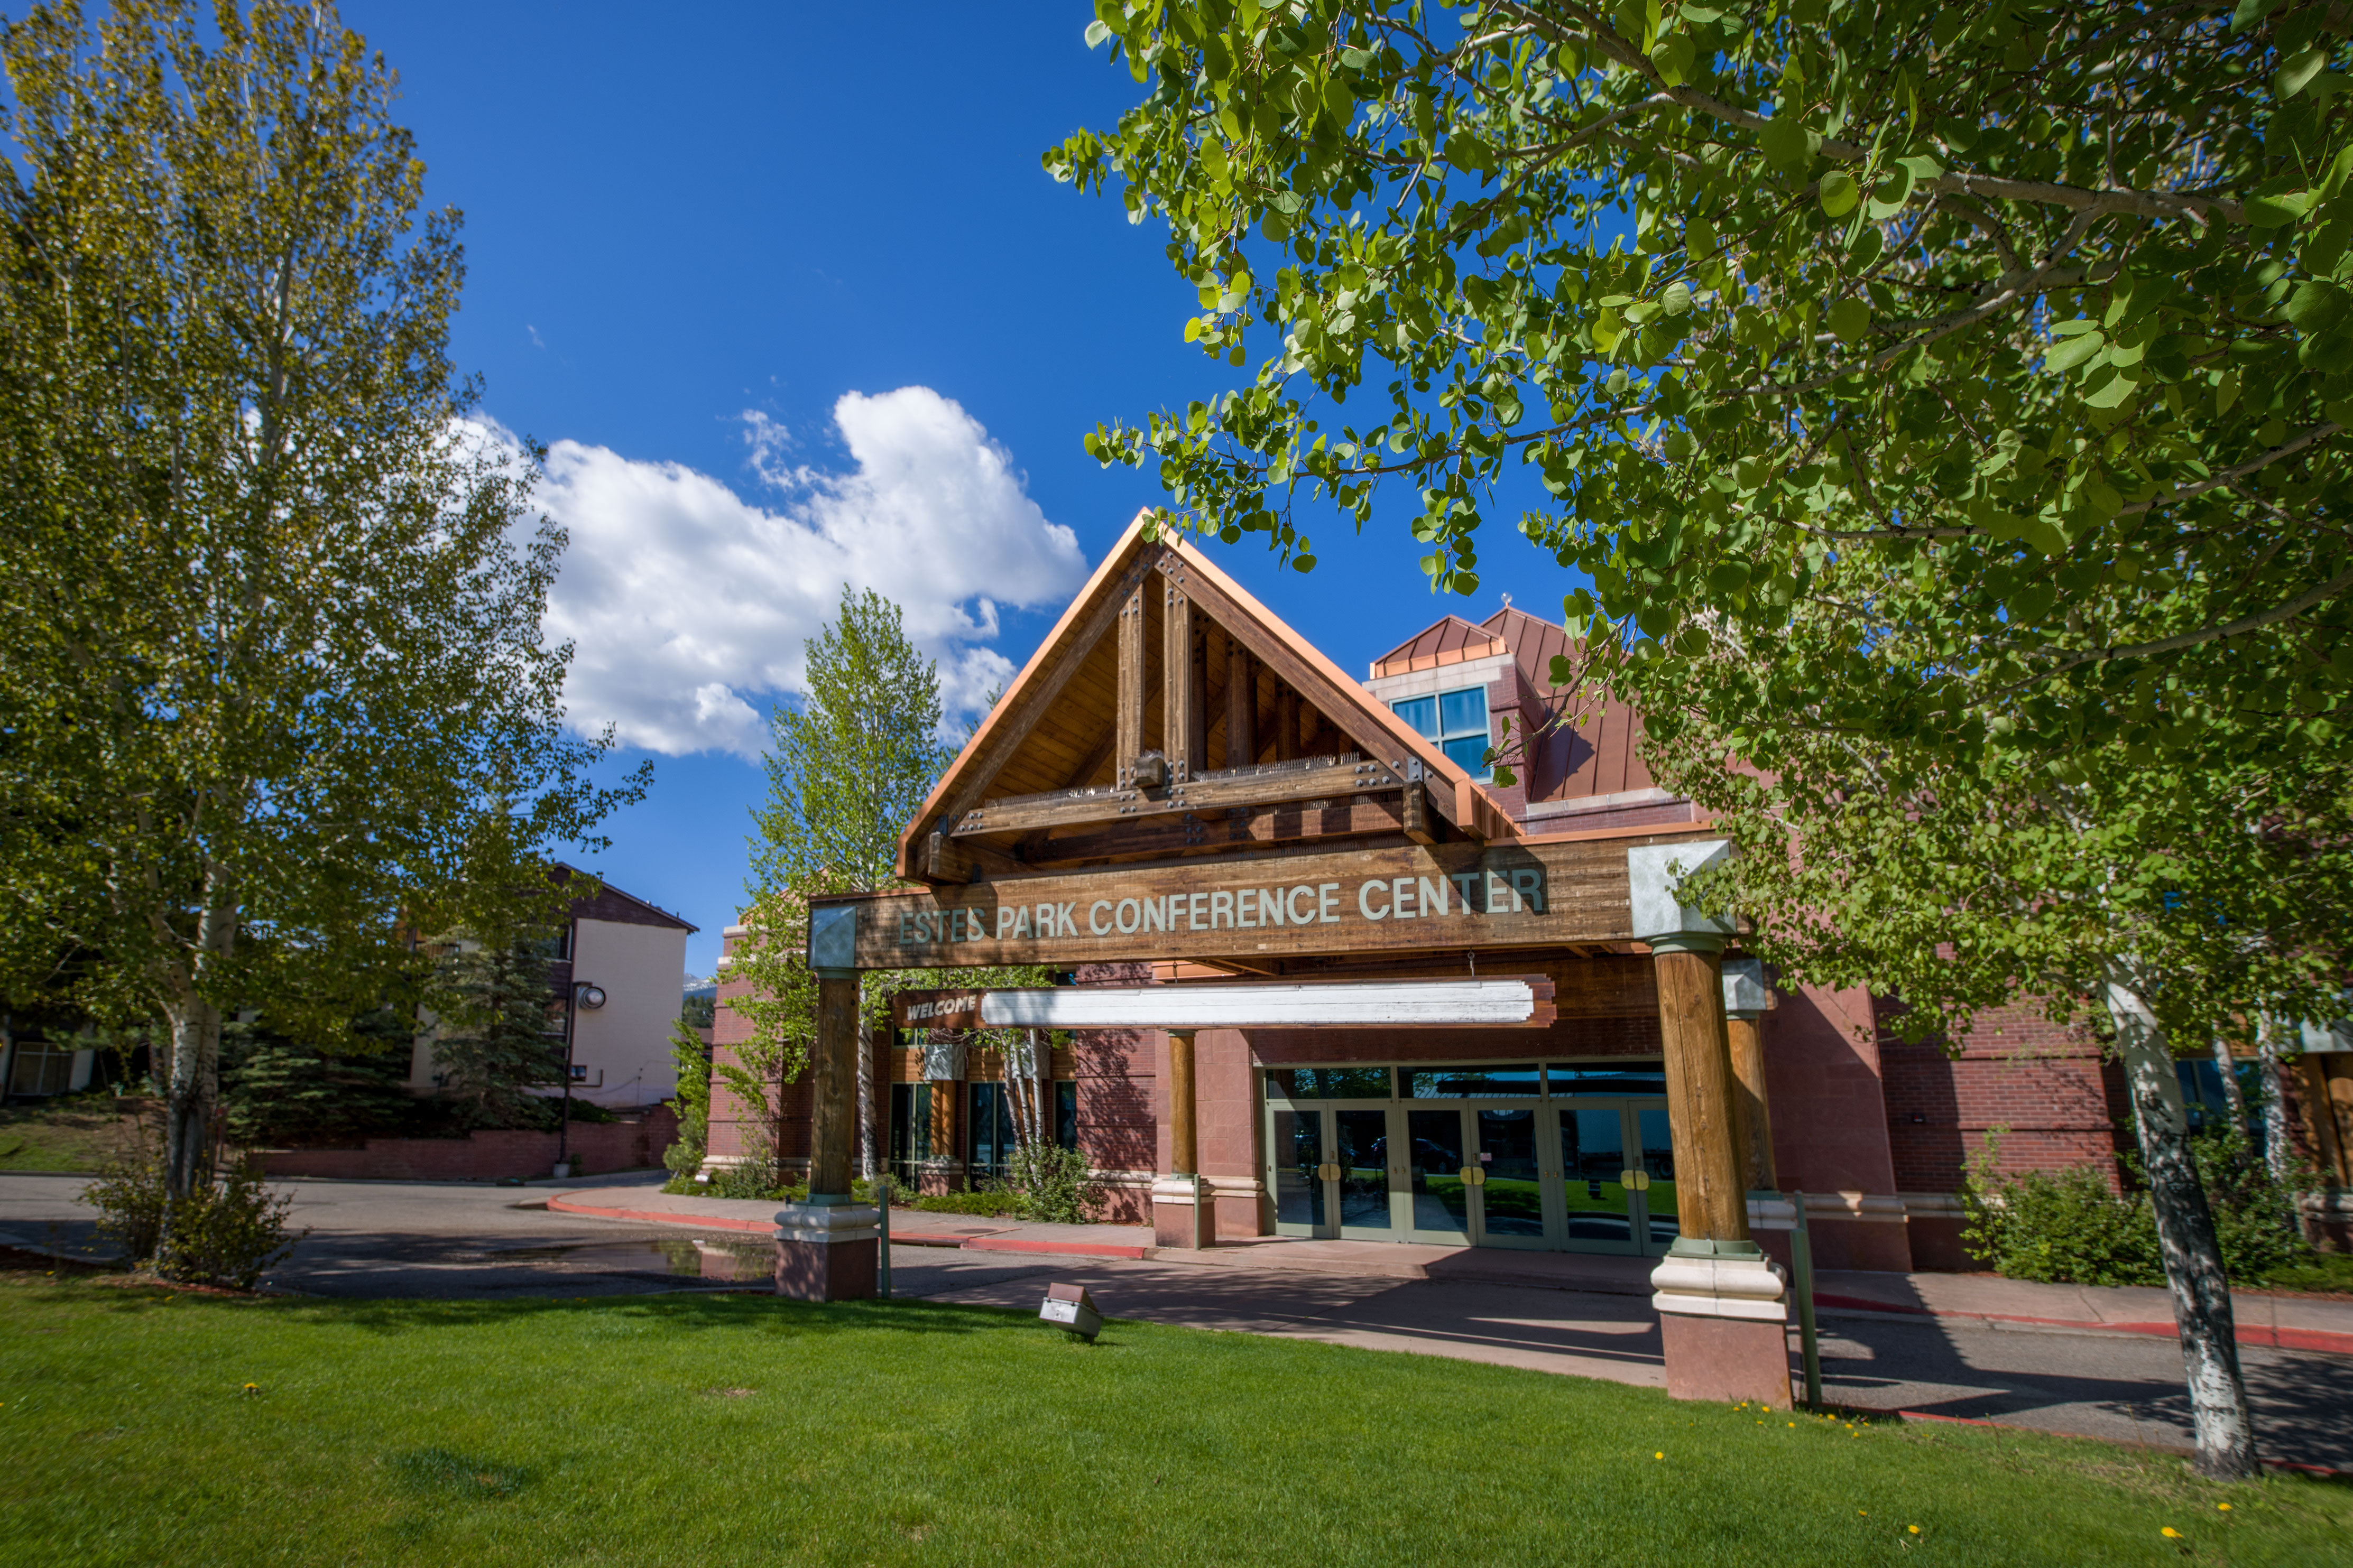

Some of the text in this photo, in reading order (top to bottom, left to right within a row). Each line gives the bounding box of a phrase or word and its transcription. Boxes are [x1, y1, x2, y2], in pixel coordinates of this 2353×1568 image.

[899, 868, 1543, 945] ESTES PARK CONFERENCE CENTER
[907, 994, 977, 1020] WELCOME
